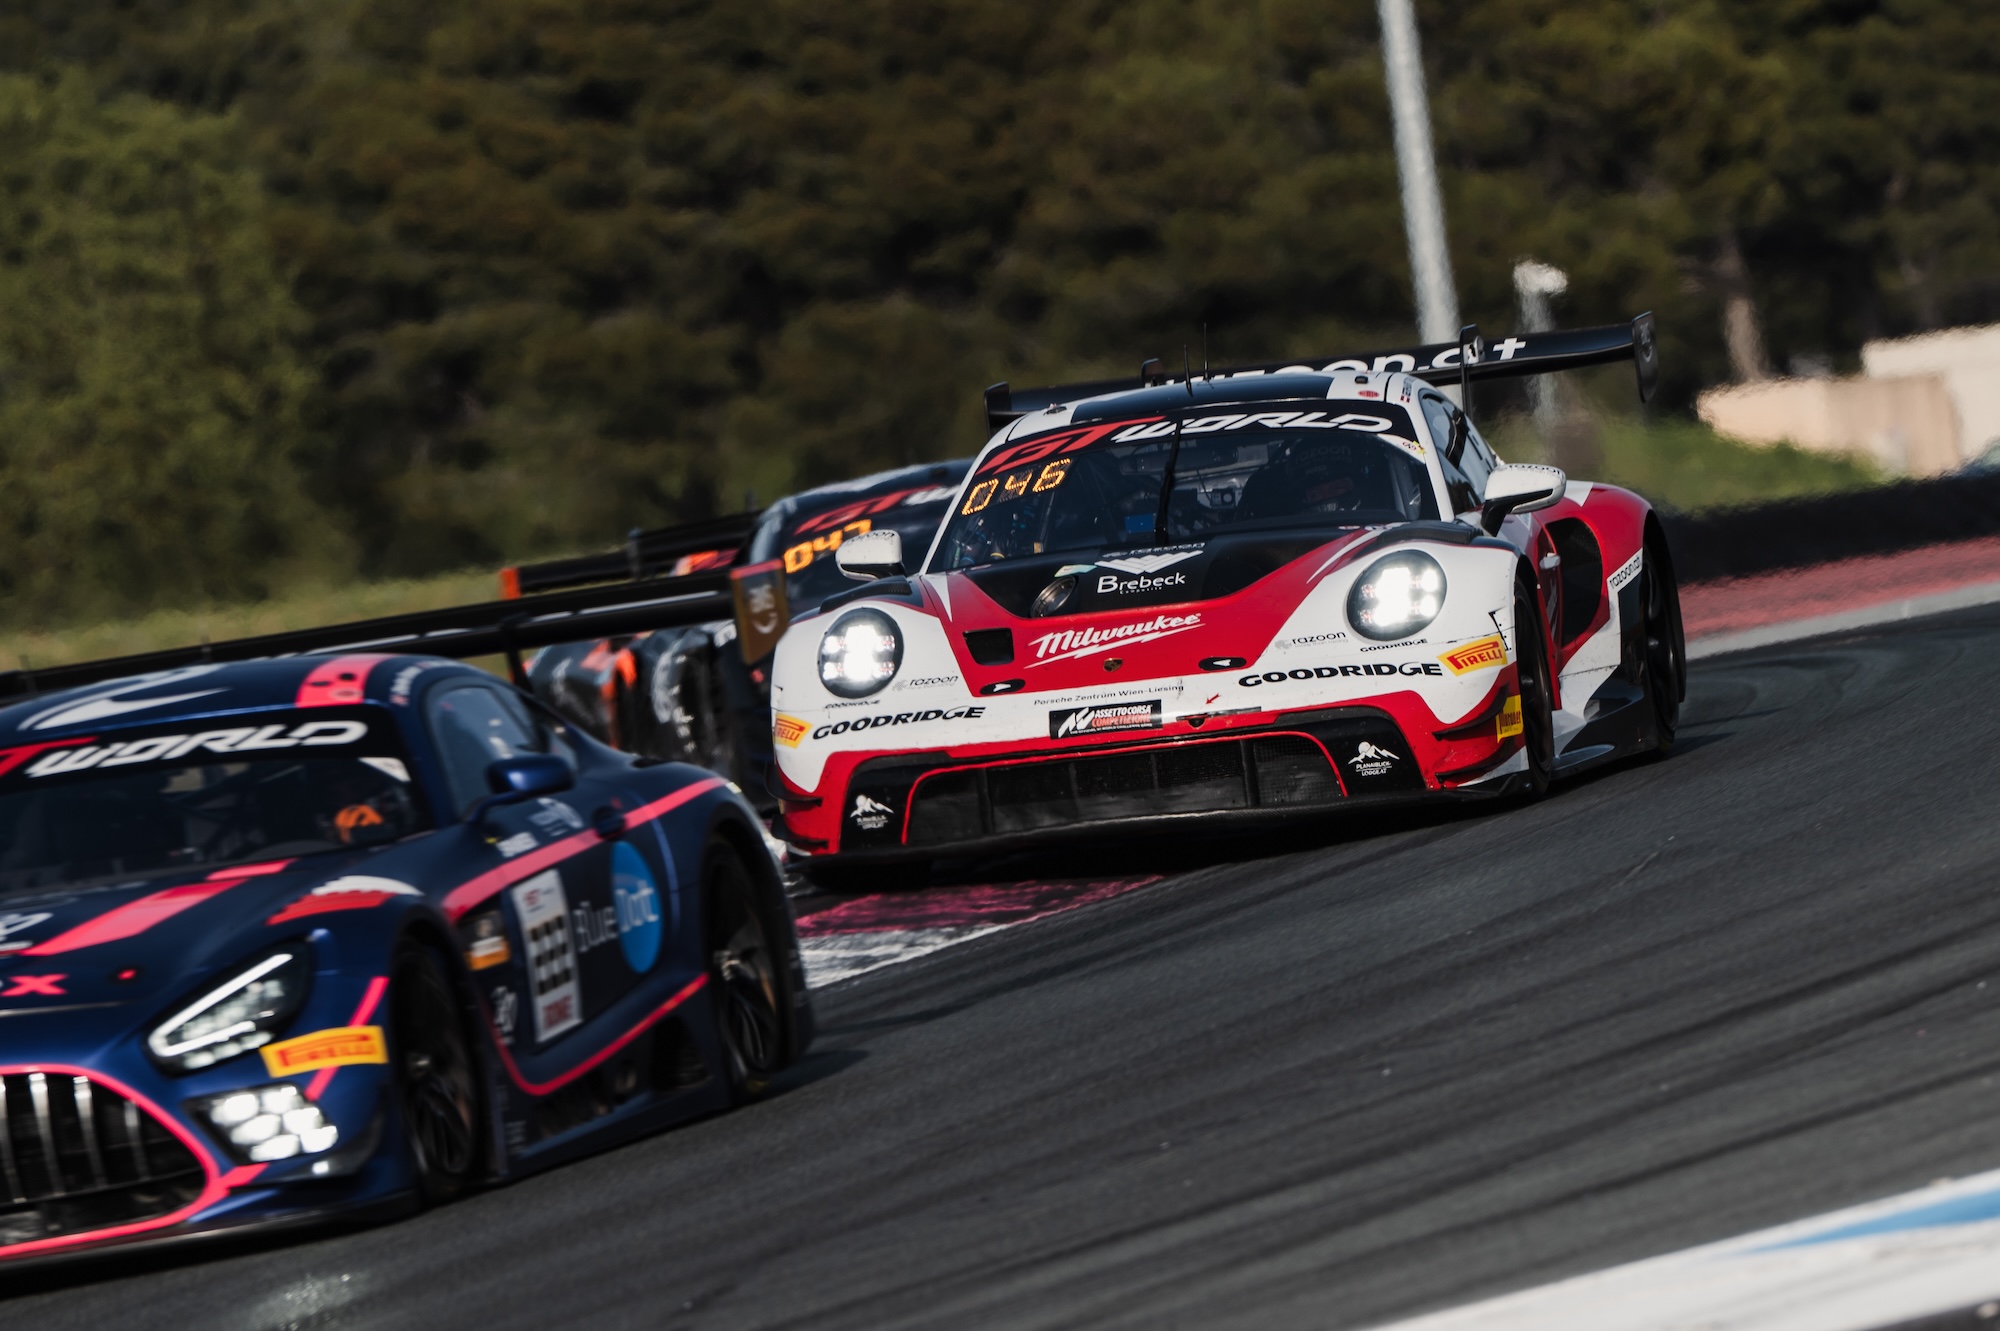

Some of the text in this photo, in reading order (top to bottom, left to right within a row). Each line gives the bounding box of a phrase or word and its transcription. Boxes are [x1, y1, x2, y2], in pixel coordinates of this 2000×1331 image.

[975, 411, 1393, 475] GT WORLD
[961, 457, 1072, 516] 046
[784, 519, 872, 573] 047
[1097, 572, 1187, 593] Brebeck
[1028, 613, 1201, 658] Milwaukee
[1292, 631, 1347, 645] razoon
[1360, 638, 1429, 653] GOODRIDGE
[1447, 640, 1503, 670] PIRELLI
[909, 675, 959, 687] razoon
[1238, 662, 1443, 687] GOODRIDGE
[1034, 696, 1073, 706] Porsche
[1075, 690, 1116, 702] Zentrum
[1094, 704, 1152, 719] ASSETTO CORSA
[812, 706, 986, 740] GOODRIDGE
[24, 721, 368, 778] WORLD
